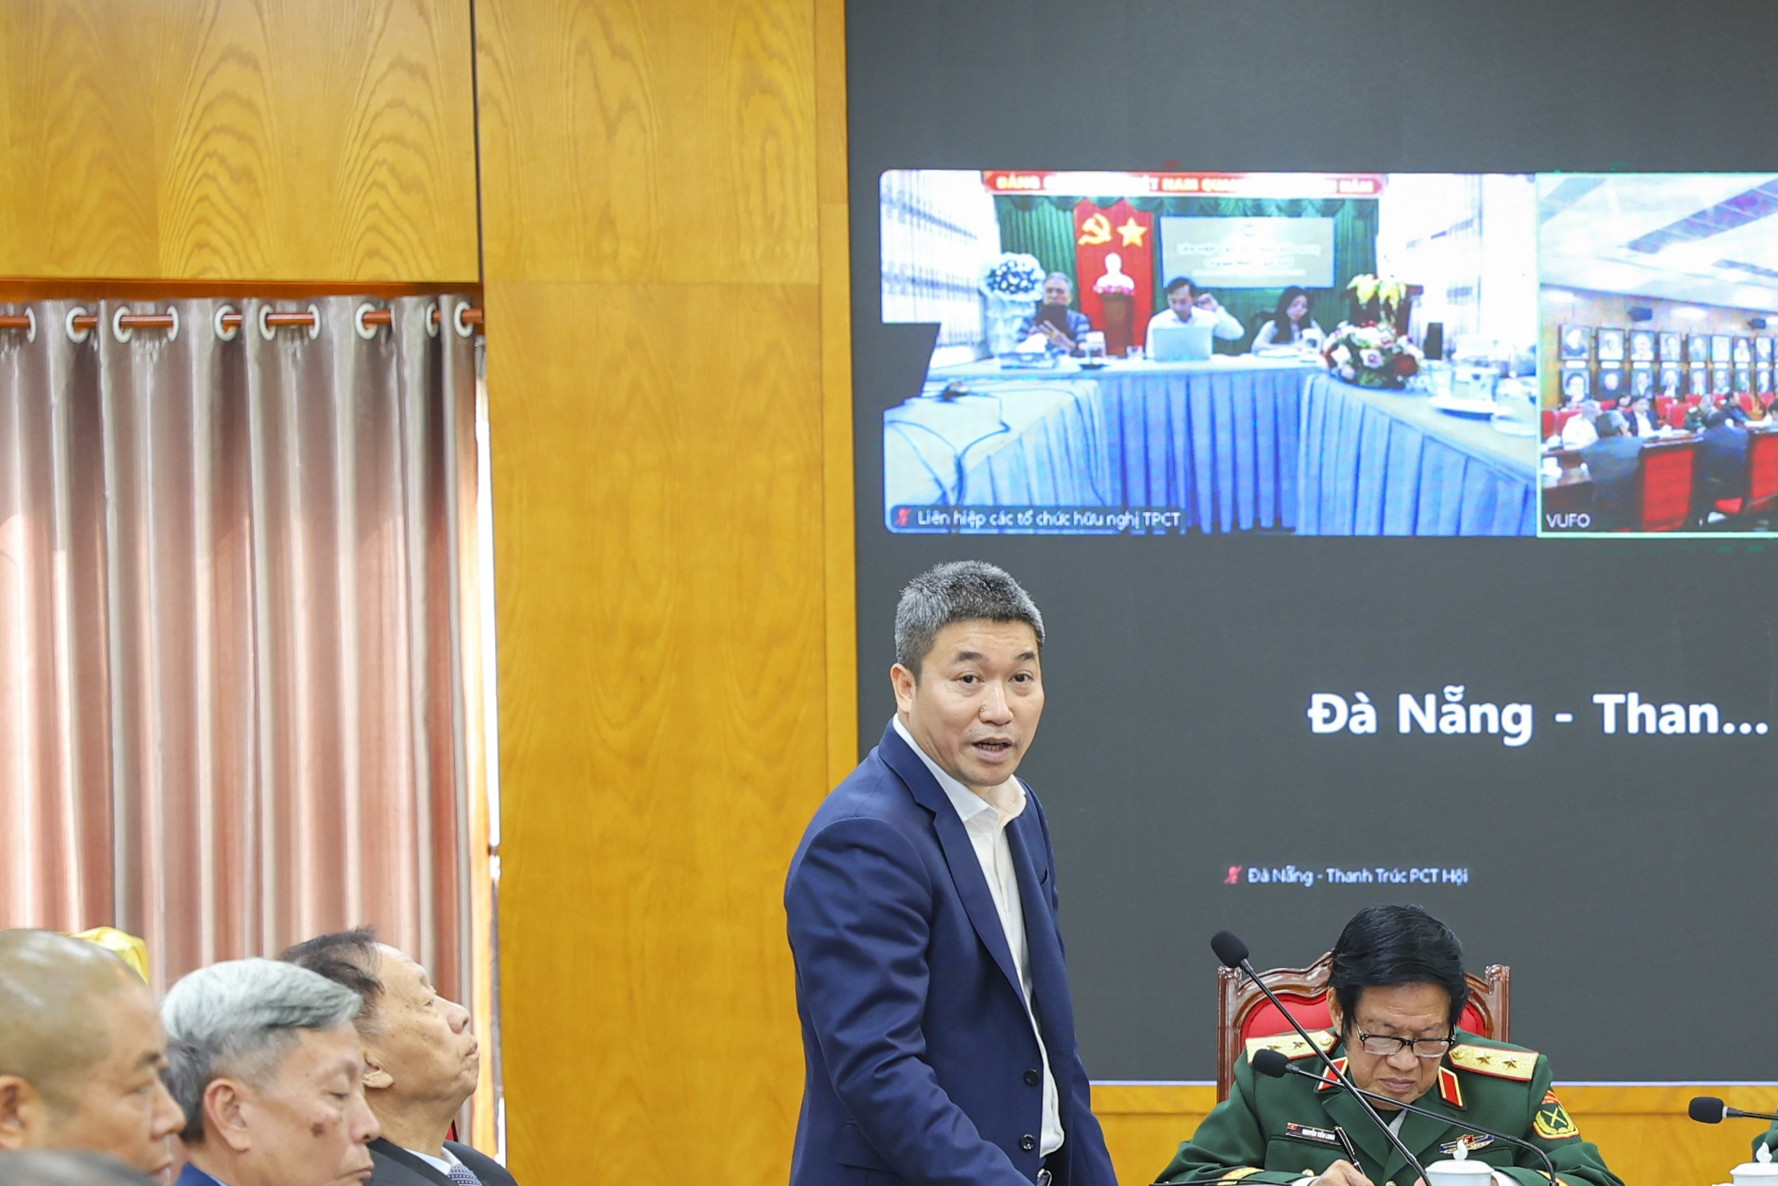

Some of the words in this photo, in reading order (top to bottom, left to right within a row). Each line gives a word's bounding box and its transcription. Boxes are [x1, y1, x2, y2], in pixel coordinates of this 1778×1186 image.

[917, 511, 949, 526] Liên
[953, 511, 985, 529] hiệp
[989, 511, 1014, 526] các
[1035, 510, 1071, 526] chức
[1105, 511, 1140, 530] nghị
[1142, 511, 1181, 526] TPCT
[1546, 513, 1591, 528] VUFO
[1307, 691, 1378, 734] Đà
[1398, 684, 1534, 747] Nẵng
[1592, 691, 1769, 734] Than...
[1247, 867, 1269, 883] Đà
[1272, 864, 1314, 887] Nẵng
[1326, 868, 1373, 883] Thanh
[1375, 867, 1407, 883] Trúc
[1409, 868, 1439, 883] PCT
[1442, 868, 1468, 886] Hội
